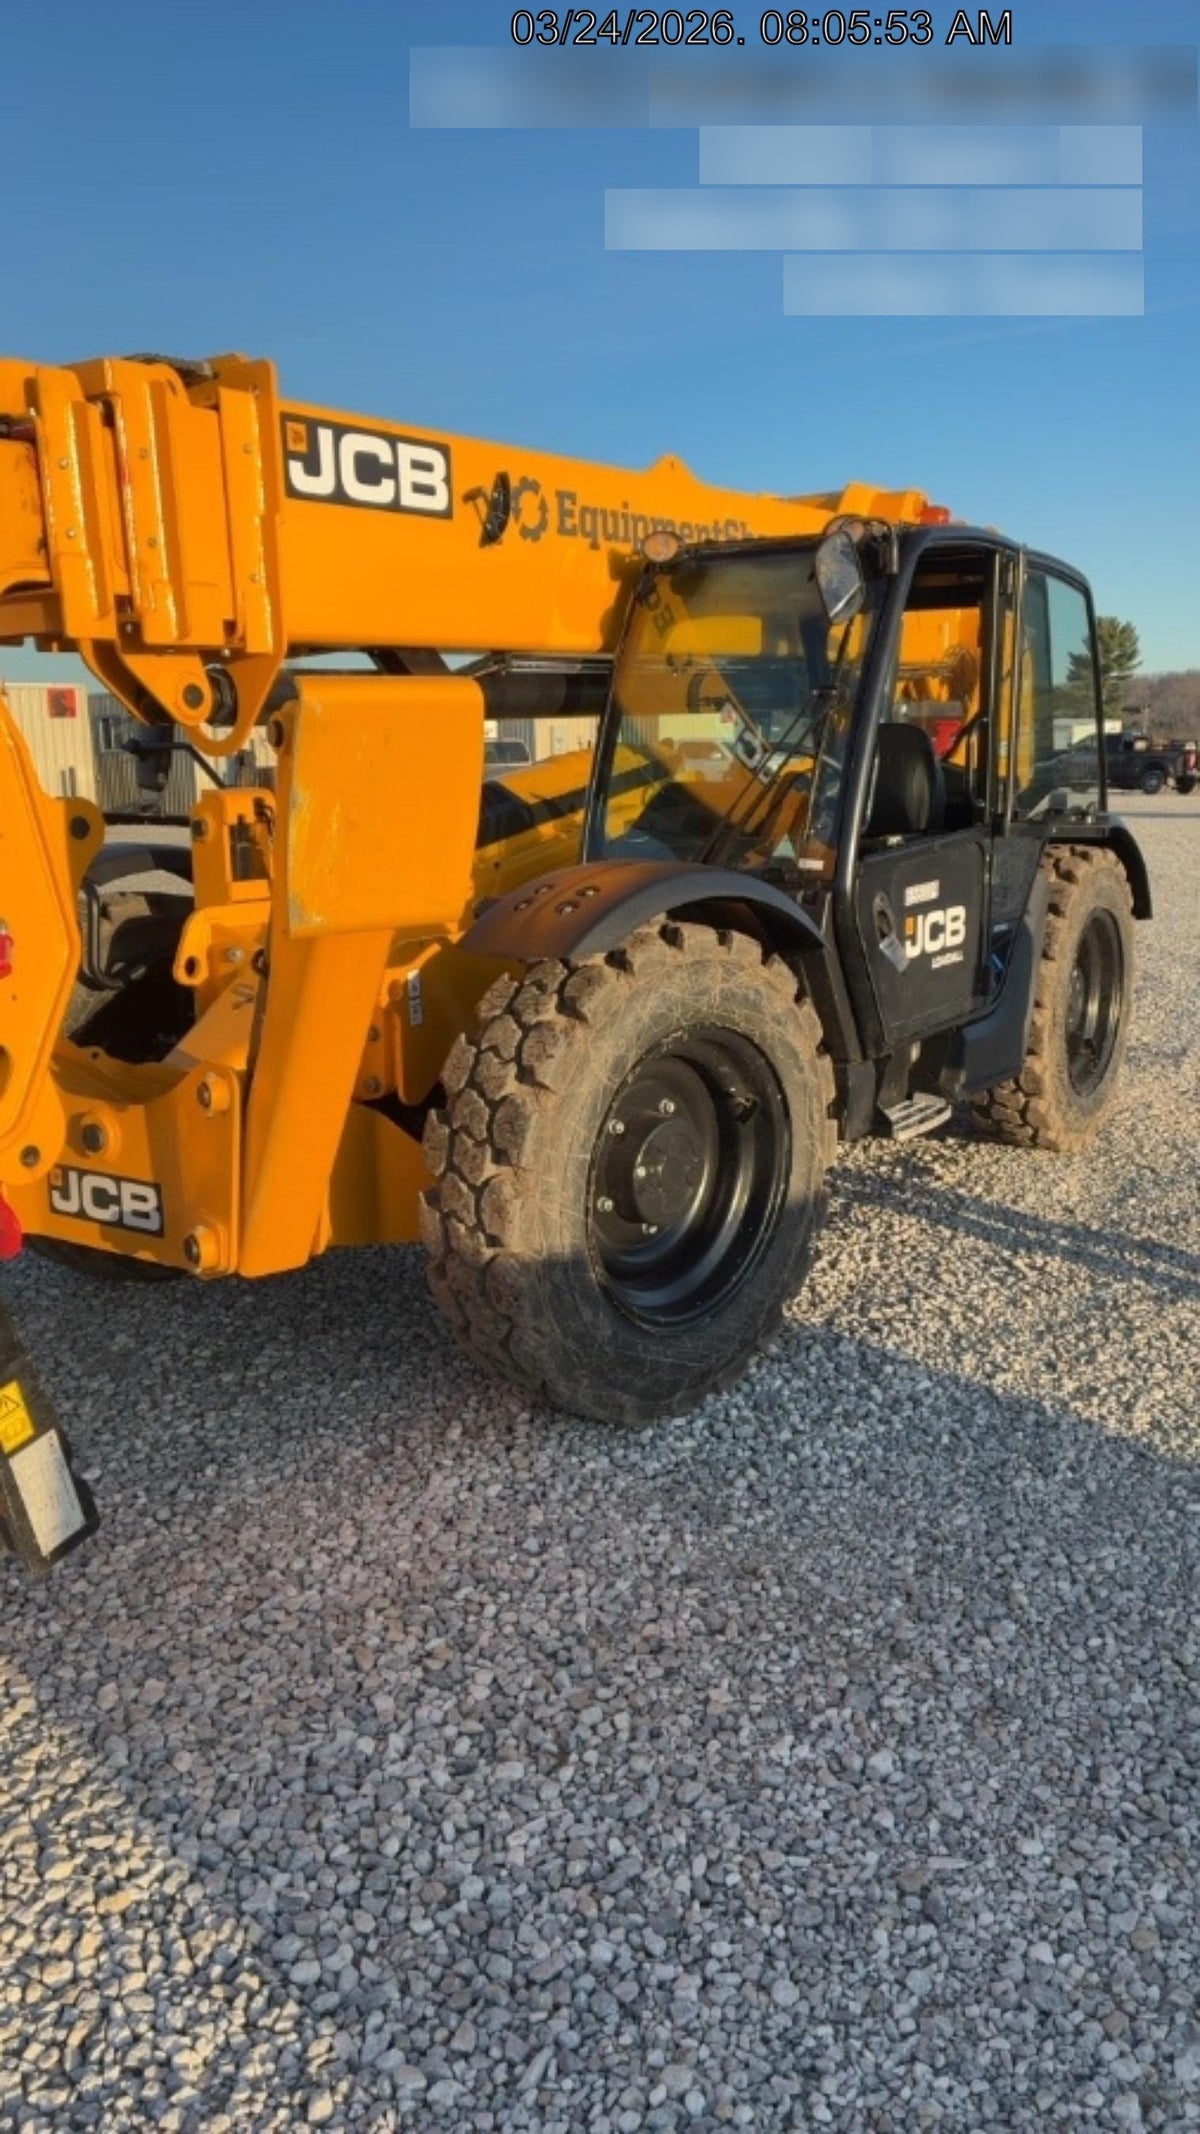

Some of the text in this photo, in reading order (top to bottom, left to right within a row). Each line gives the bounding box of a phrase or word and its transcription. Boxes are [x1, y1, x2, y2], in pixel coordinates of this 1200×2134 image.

[287, 426, 450, 512] JCB
[555, 489, 754, 556] EquipmentSh
[905, 905, 966, 959] JCB
[51, 1170, 160, 1232] JCB
